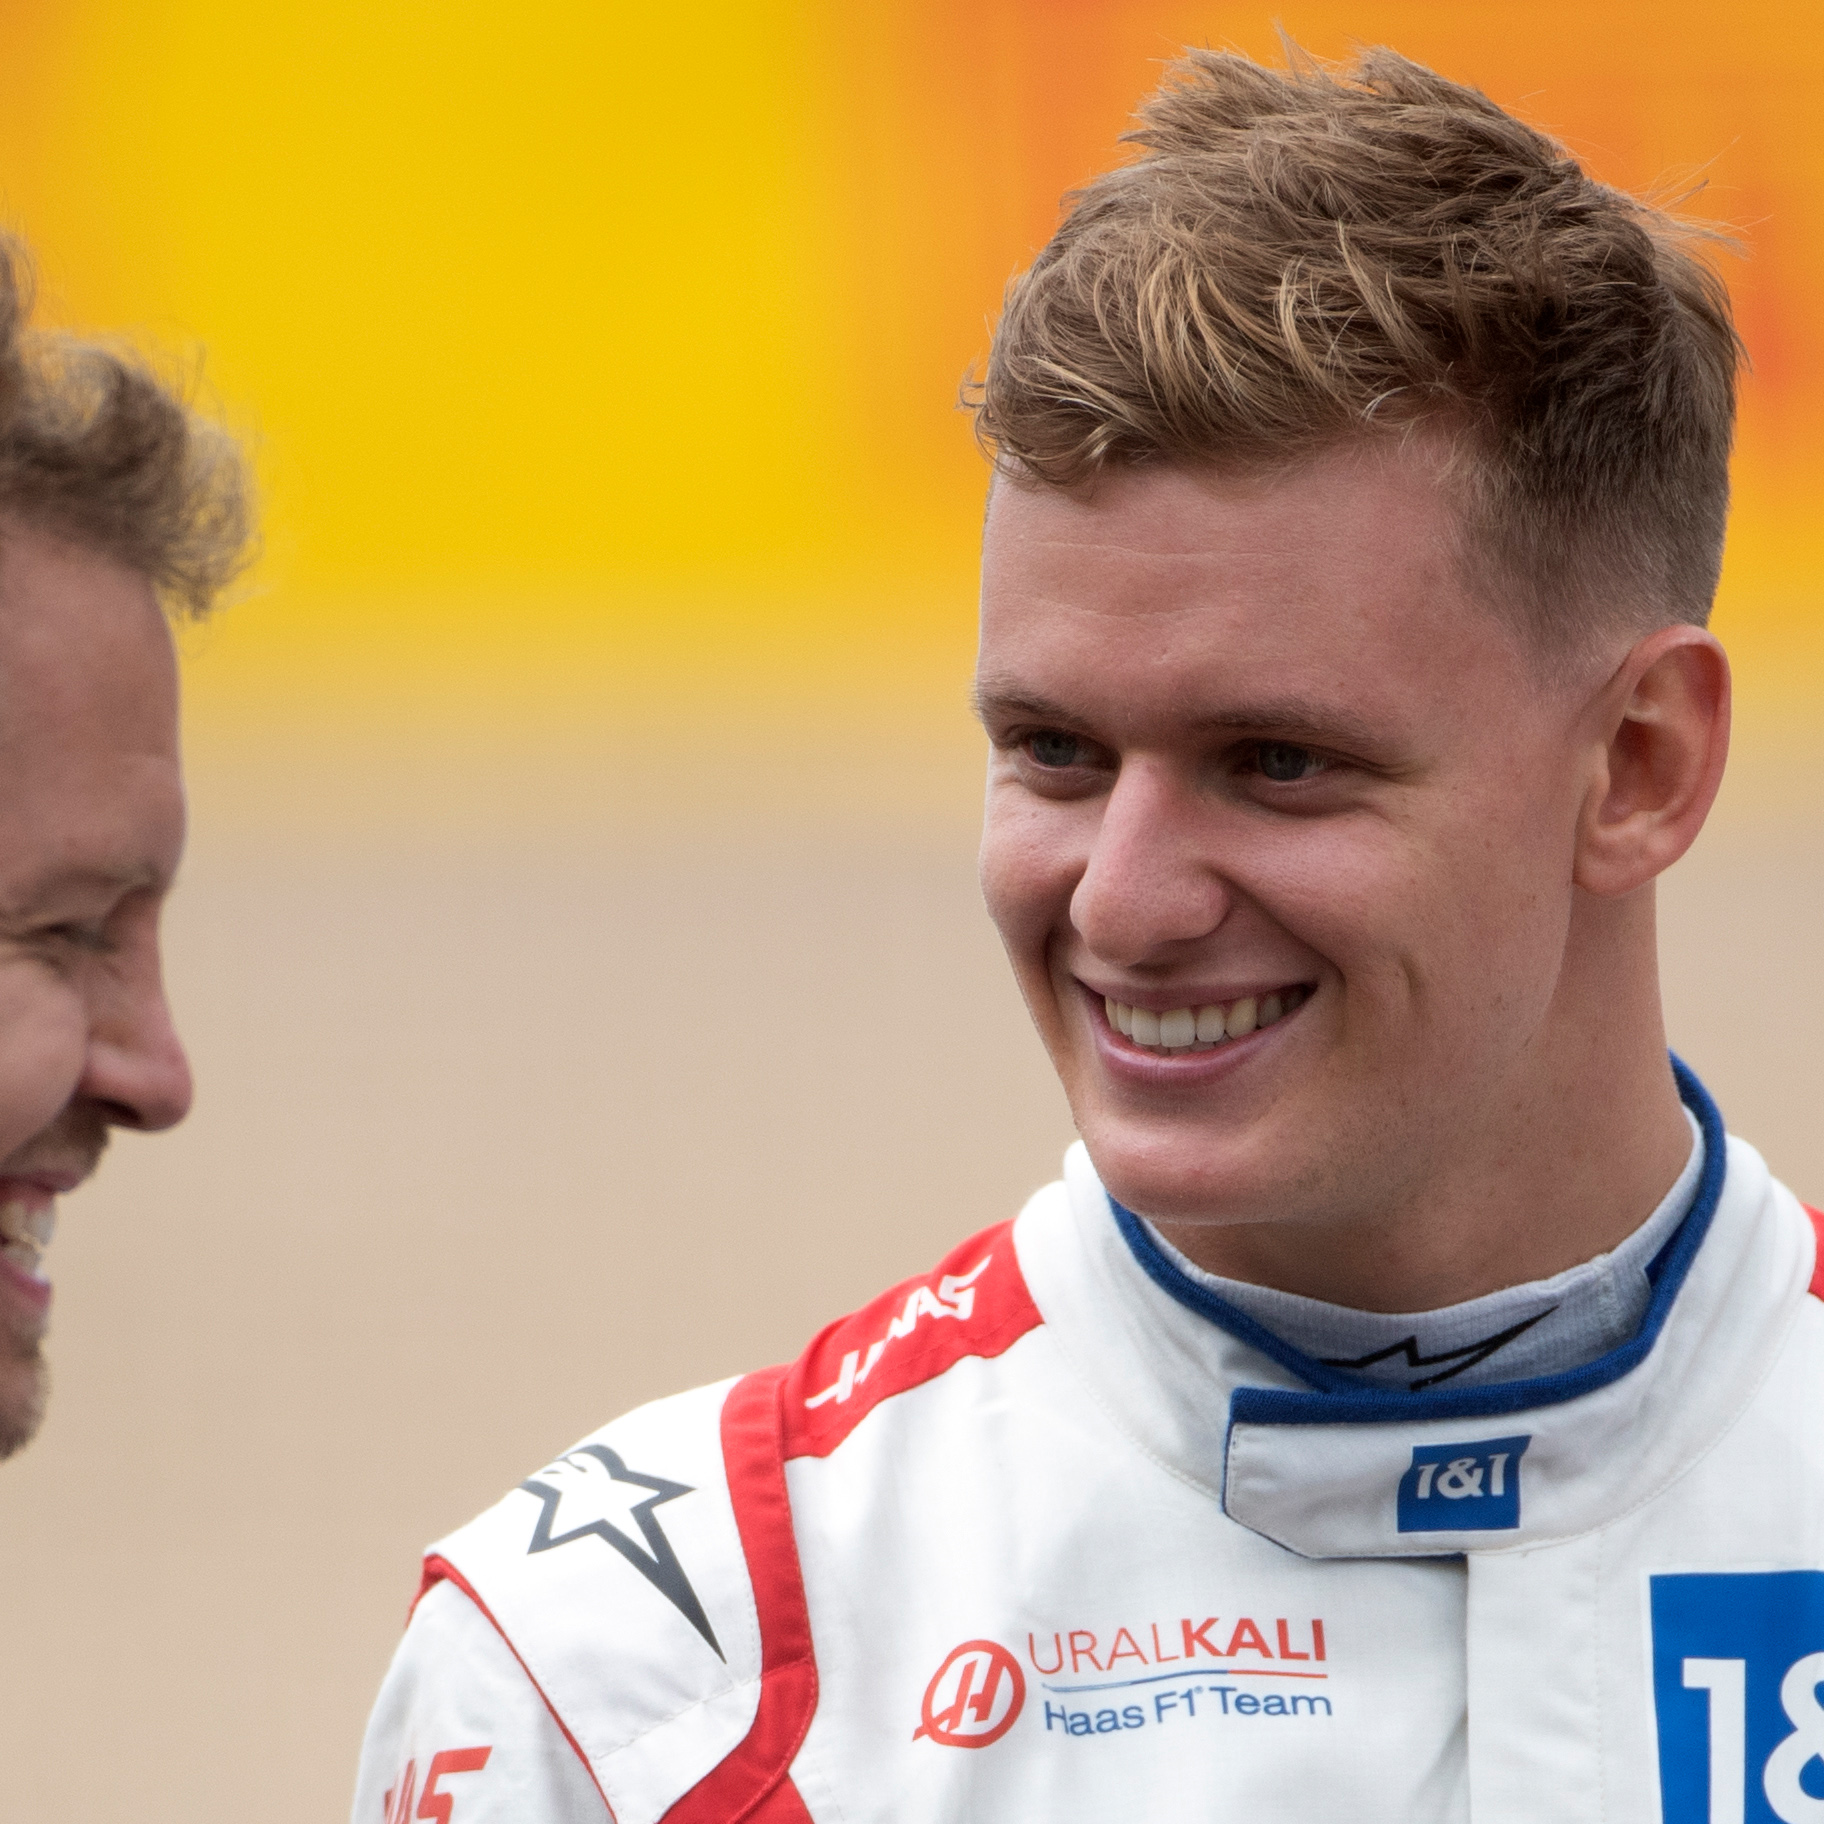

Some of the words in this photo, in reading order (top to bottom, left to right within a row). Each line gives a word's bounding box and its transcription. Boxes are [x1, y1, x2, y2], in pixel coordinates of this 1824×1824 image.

[1416, 1453, 1510, 1500] 1&1
[1028, 1617, 1327, 1675] URALKALI
[1044, 1701, 1145, 1736] Haas
[1209, 1686, 1333, 1717] Team
